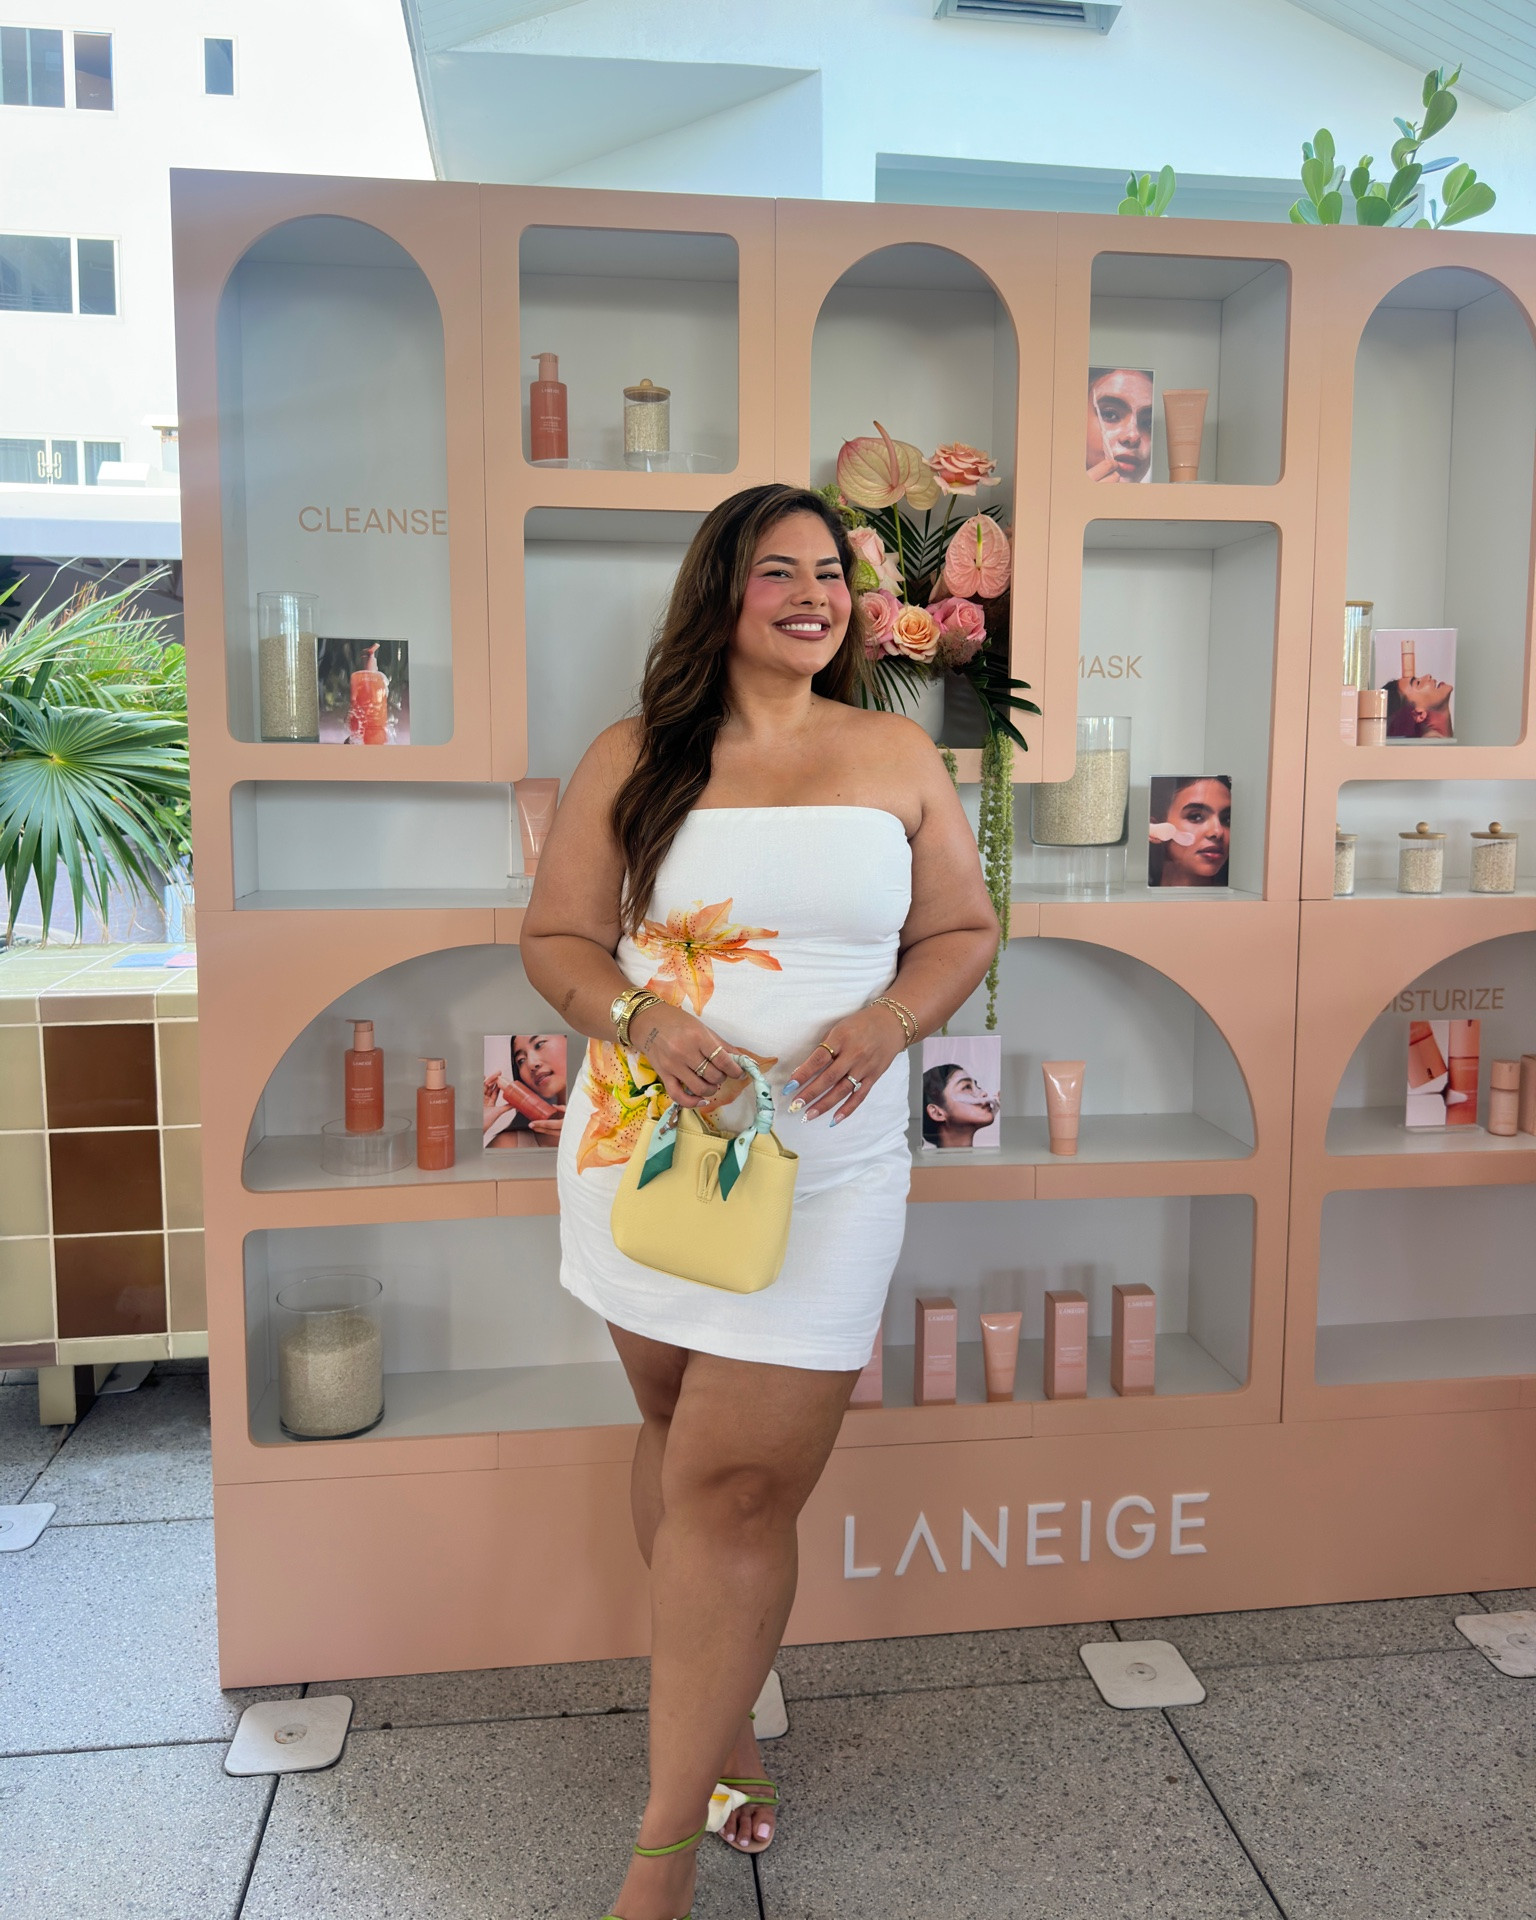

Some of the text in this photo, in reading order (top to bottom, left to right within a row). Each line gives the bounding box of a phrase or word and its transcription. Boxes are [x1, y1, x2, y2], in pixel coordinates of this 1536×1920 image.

[298, 505, 448, 536] CLEANSE
[1381, 987, 1505, 1014] ISTURIZE
[844, 1492, 1211, 1580] LANEIGE
